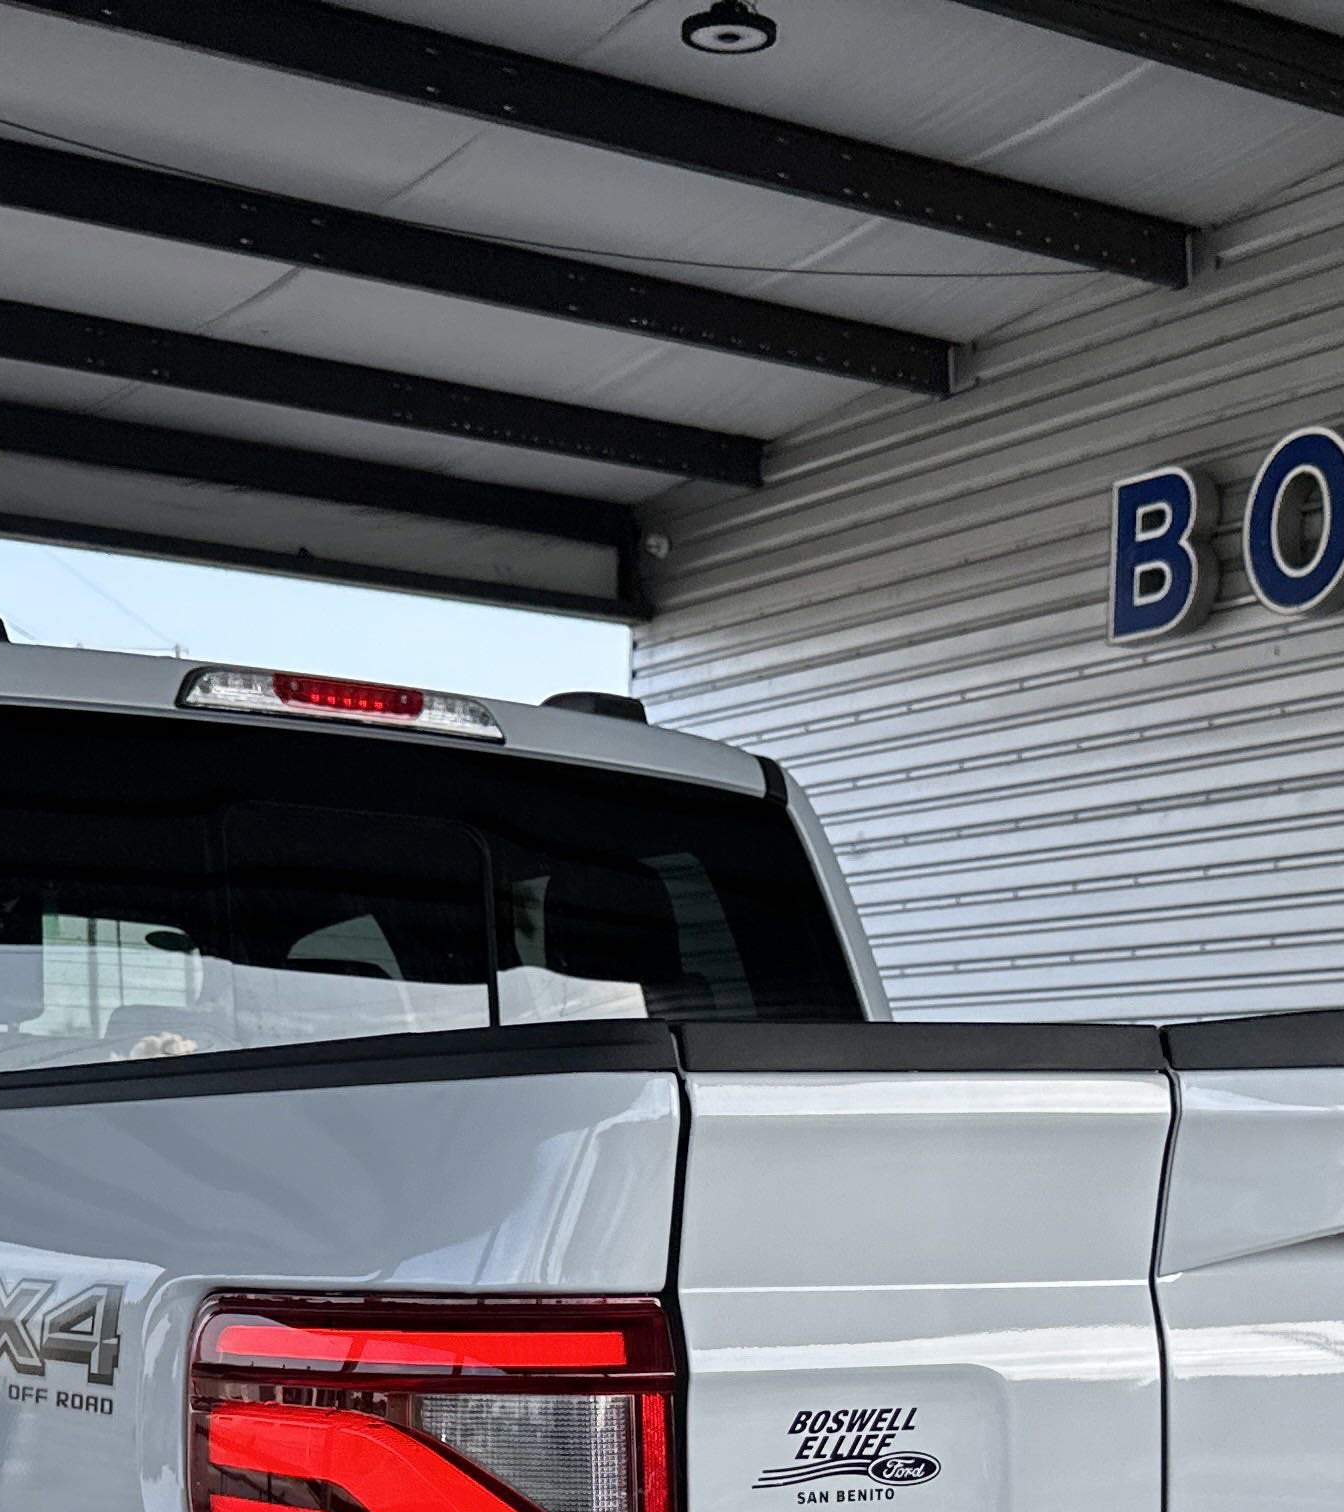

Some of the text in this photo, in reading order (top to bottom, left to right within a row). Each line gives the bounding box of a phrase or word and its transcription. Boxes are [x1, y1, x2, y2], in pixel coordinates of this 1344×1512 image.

[8, 1384, 114, 1416] OFF ROAD
[787, 1407, 918, 1435] BOSWELL
[794, 1433, 897, 1460] ELLIFF
[882, 1458, 926, 1479] Ford
[796, 1488, 895, 1505] SAN BENITO
